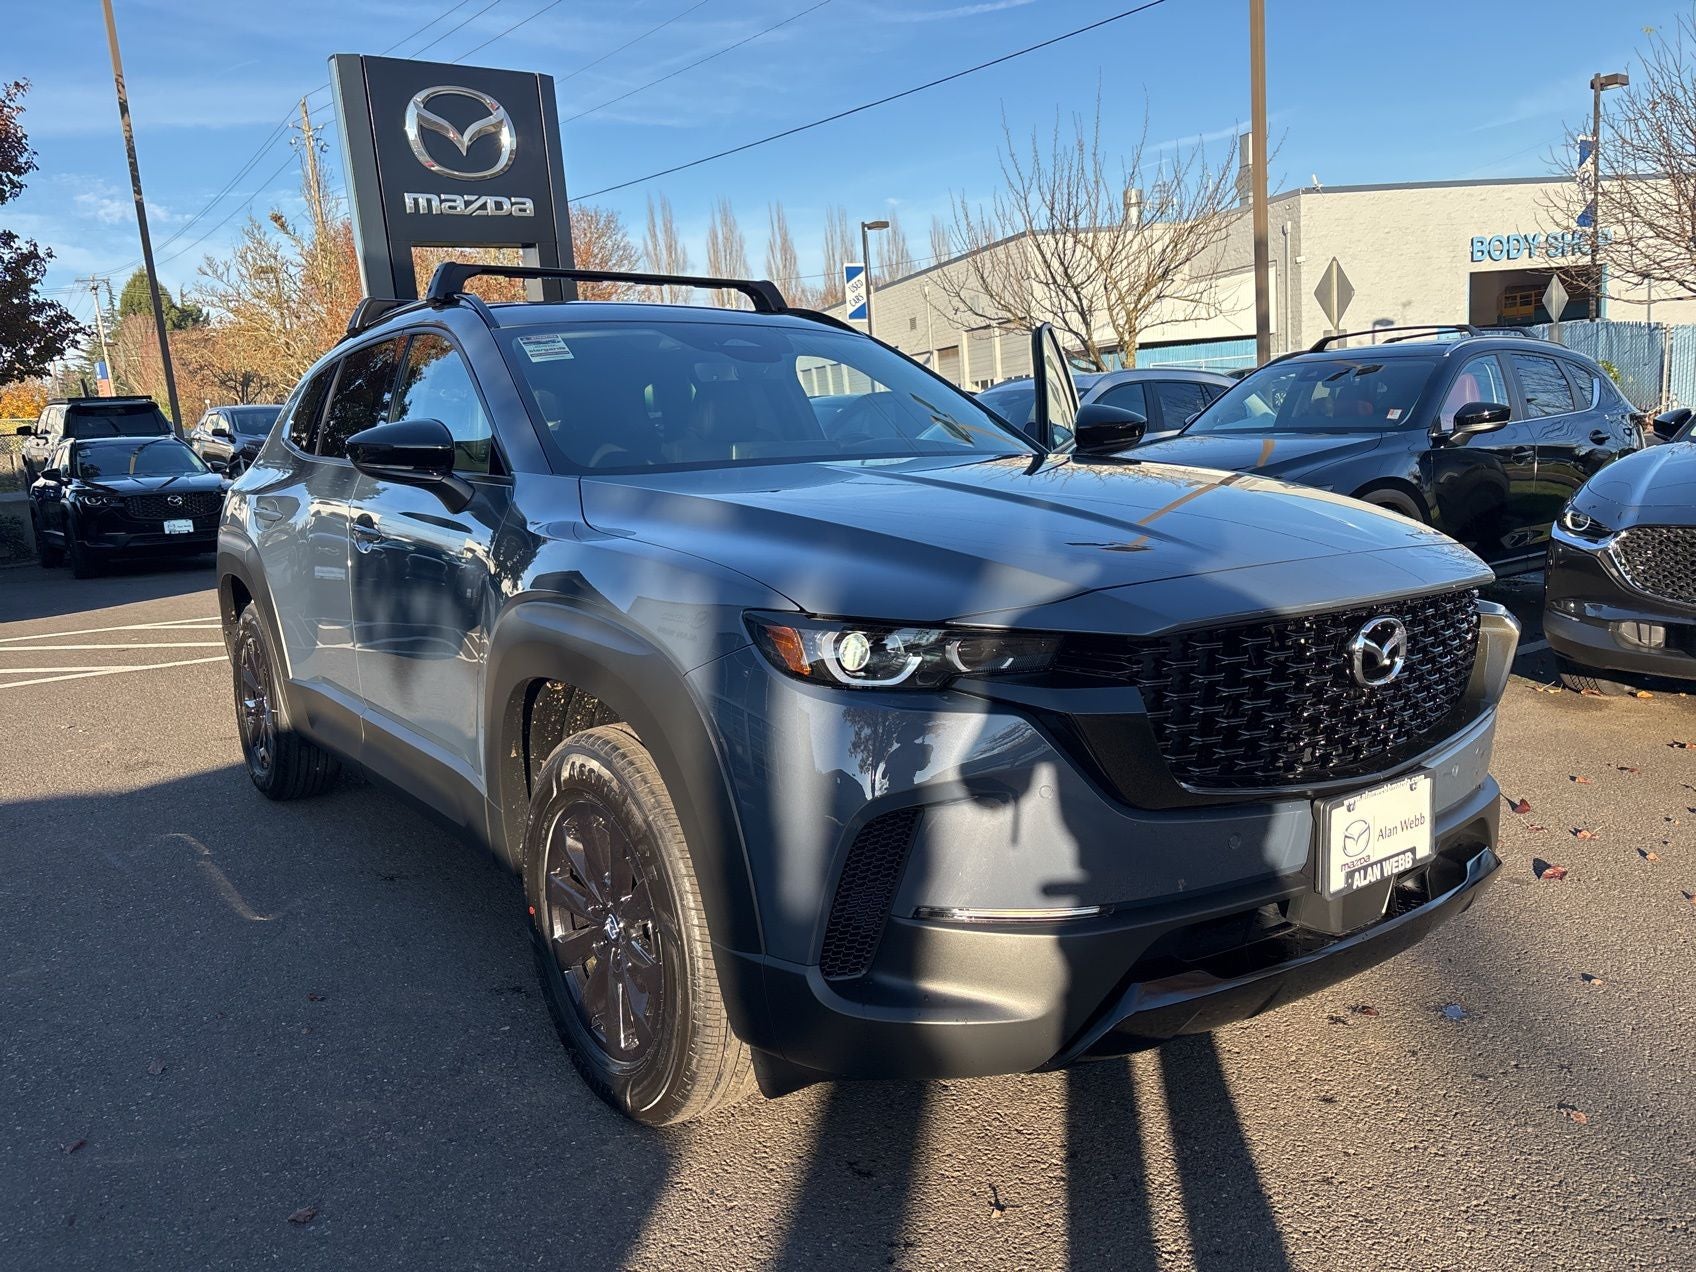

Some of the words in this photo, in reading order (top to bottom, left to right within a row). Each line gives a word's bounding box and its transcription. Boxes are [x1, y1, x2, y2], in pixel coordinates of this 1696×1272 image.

[1471, 233, 1540, 262] BODY
[848, 279, 864, 293] USED
[849, 293, 865, 308] CARS
[1377, 826, 1398, 842] Alan
[1400, 813, 1426, 833] Webb
[1353, 863, 1380, 889] ALAN
[1383, 852, 1414, 877] WEBB
